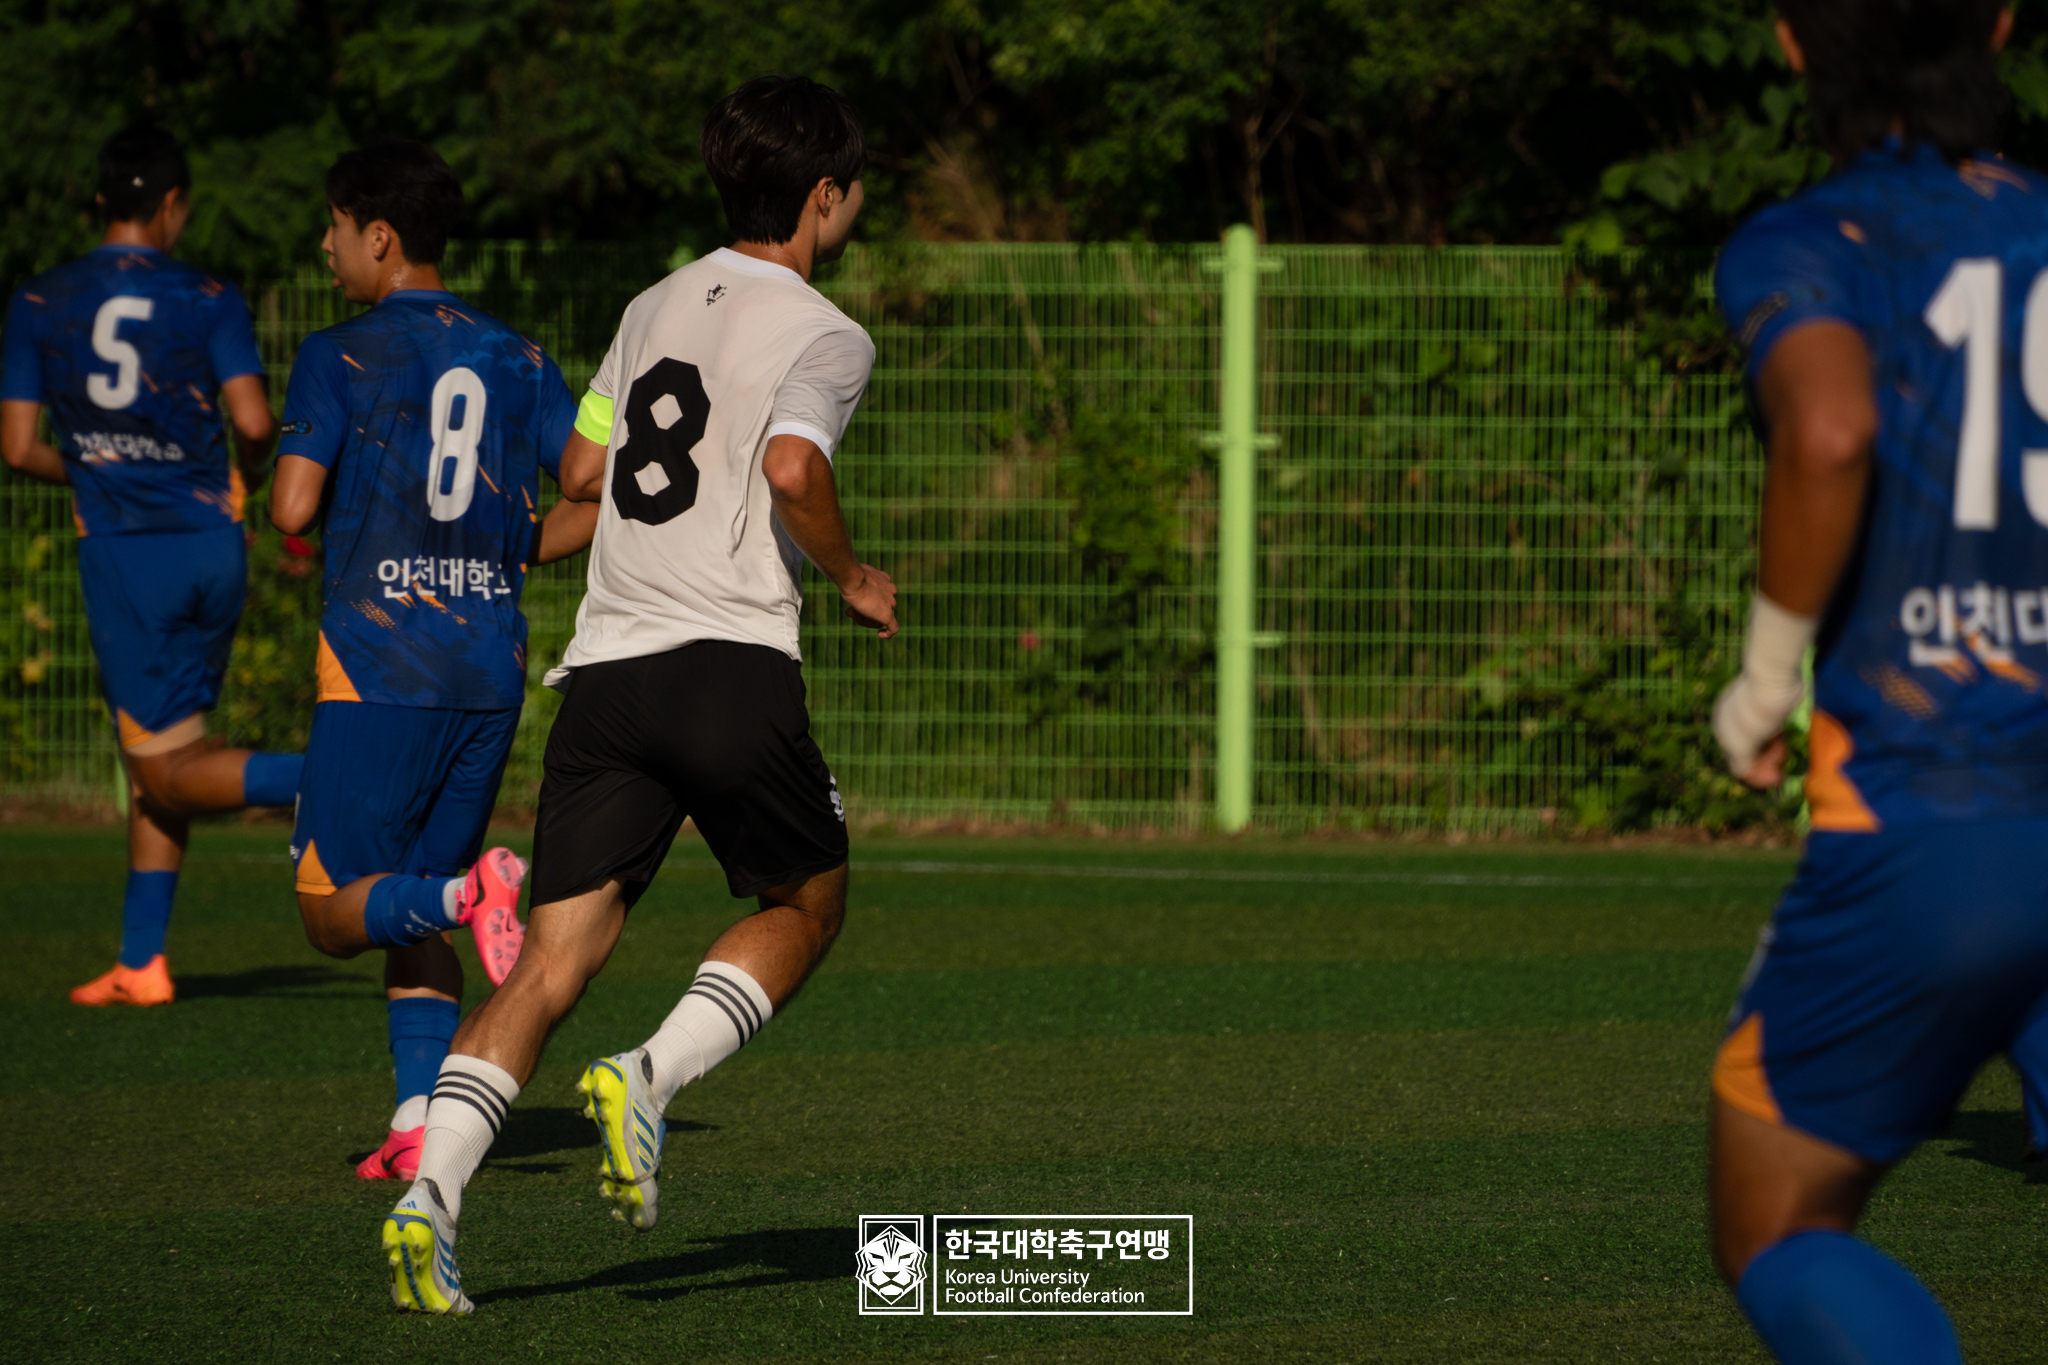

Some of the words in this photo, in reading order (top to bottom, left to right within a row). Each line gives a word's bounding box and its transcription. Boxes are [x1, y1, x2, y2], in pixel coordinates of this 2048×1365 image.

[87, 295, 154, 409] 5
[1925, 257, 2048, 530] 1
[427, 366, 487, 522] 8
[611, 356, 711, 527] 8
